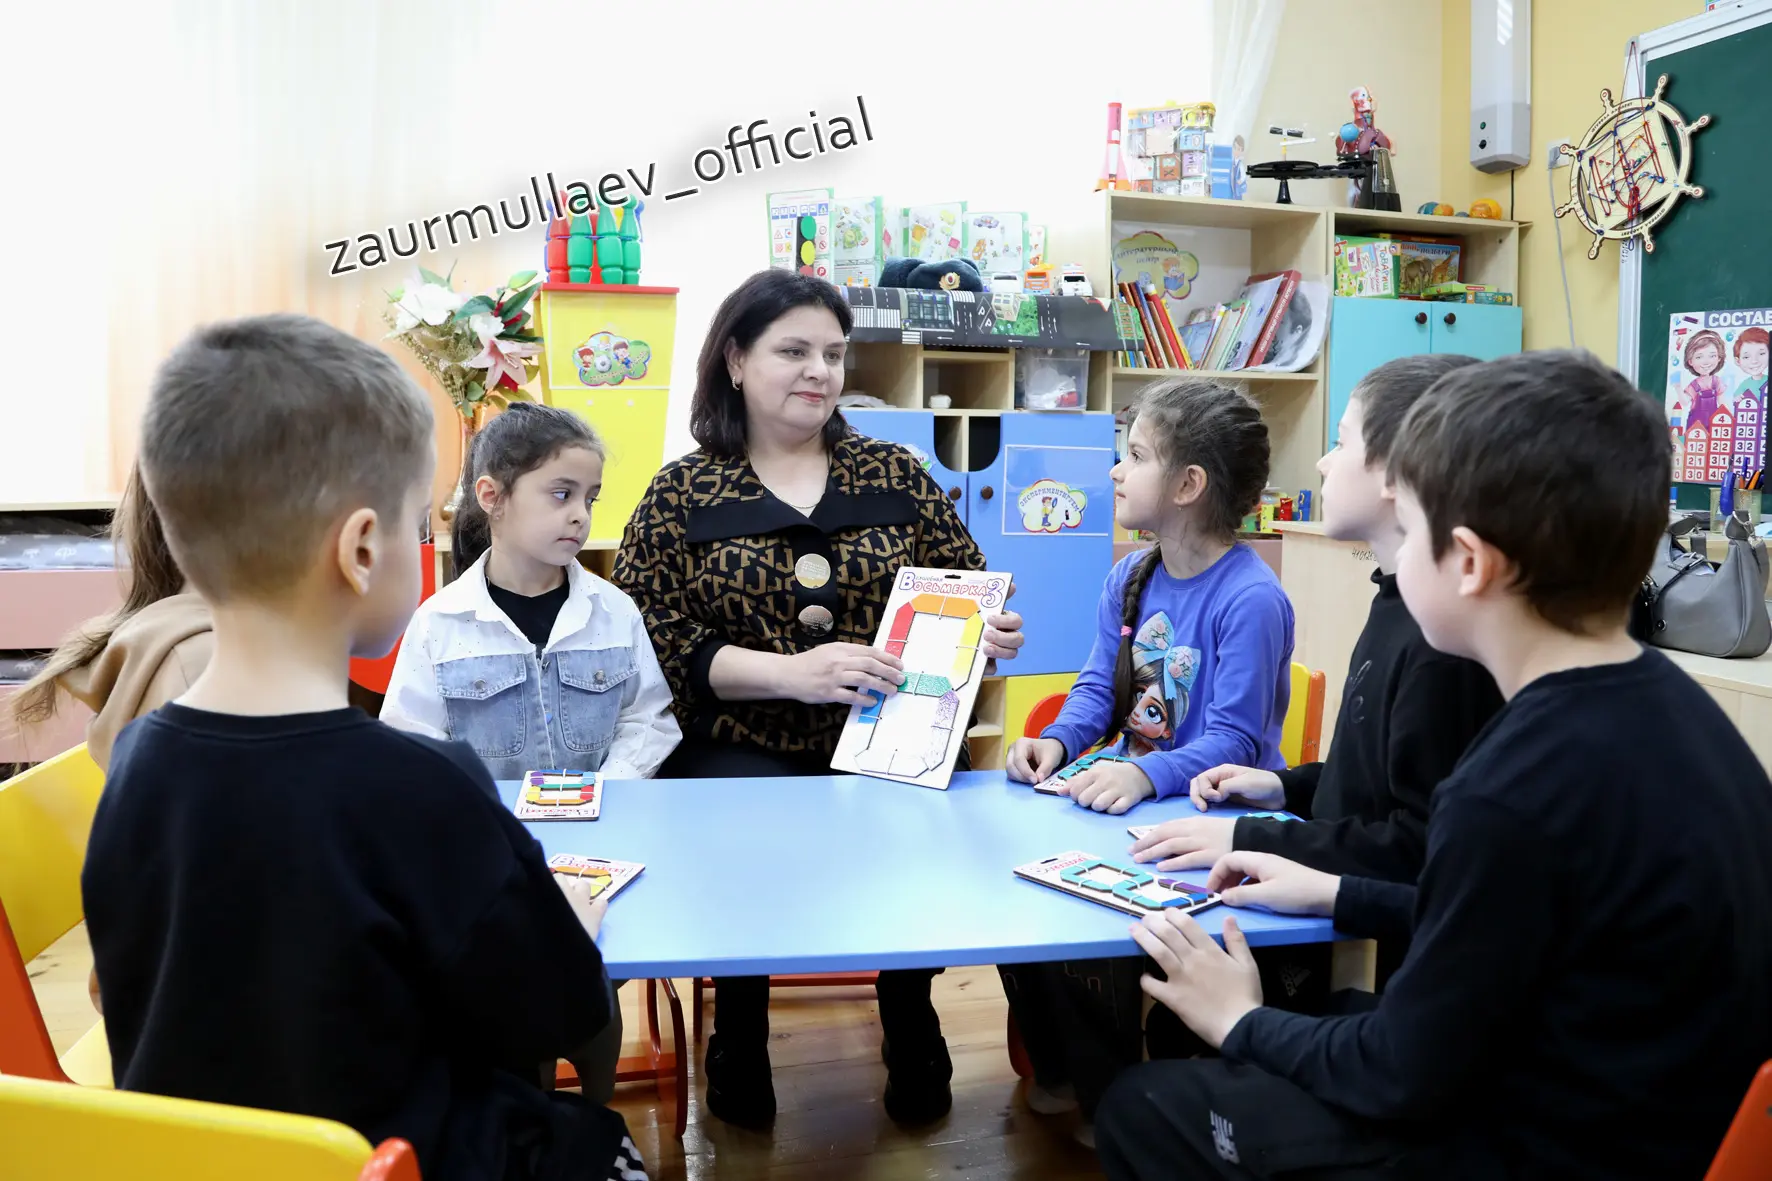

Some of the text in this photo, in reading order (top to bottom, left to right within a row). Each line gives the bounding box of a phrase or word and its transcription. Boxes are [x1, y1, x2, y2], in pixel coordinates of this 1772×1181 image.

[1745, 400, 1751, 408] 5
[1749, 414, 1756, 422] 4
[1694, 430, 1700, 439] 3
[1738, 428, 1754, 436] 2 3
[1698, 444, 1704, 452] 2
[1712, 443, 1728, 451] 2 2
[1737, 442, 1753, 450] 3 2
[1687, 471, 1702, 480] 3 0
[1710, 470, 1717, 478] 4
